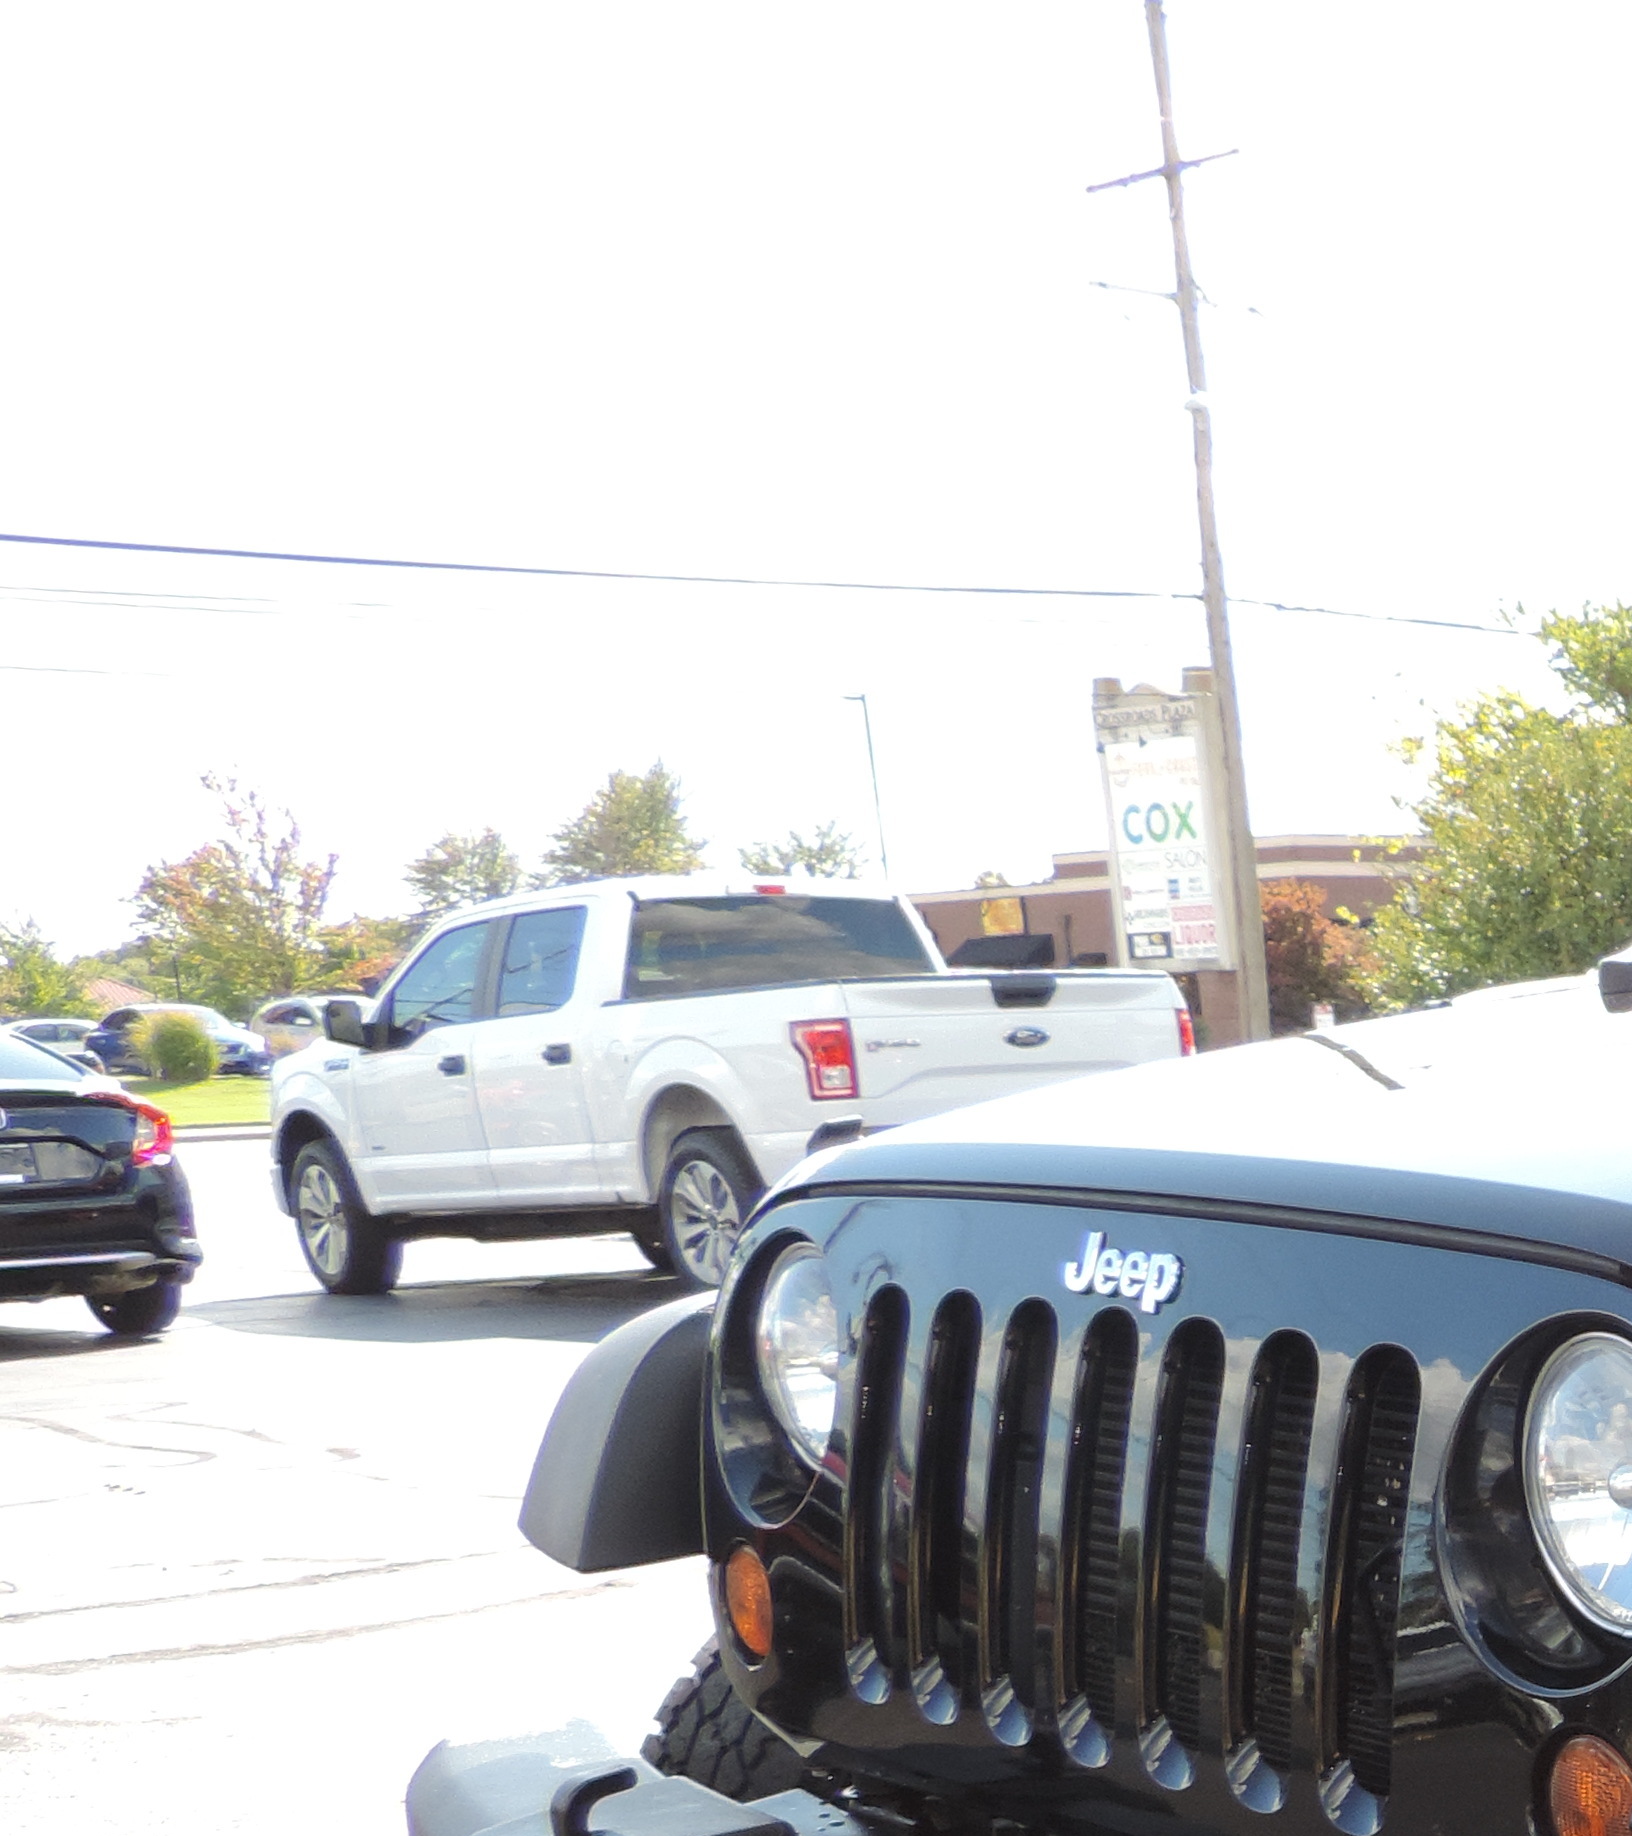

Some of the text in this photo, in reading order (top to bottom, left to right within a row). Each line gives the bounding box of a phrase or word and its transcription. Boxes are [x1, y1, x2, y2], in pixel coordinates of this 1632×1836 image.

[1122, 801, 1198, 845] COX
[1164, 849, 1207, 869] SALON
[1064, 1231, 1182, 1314] Jeep
